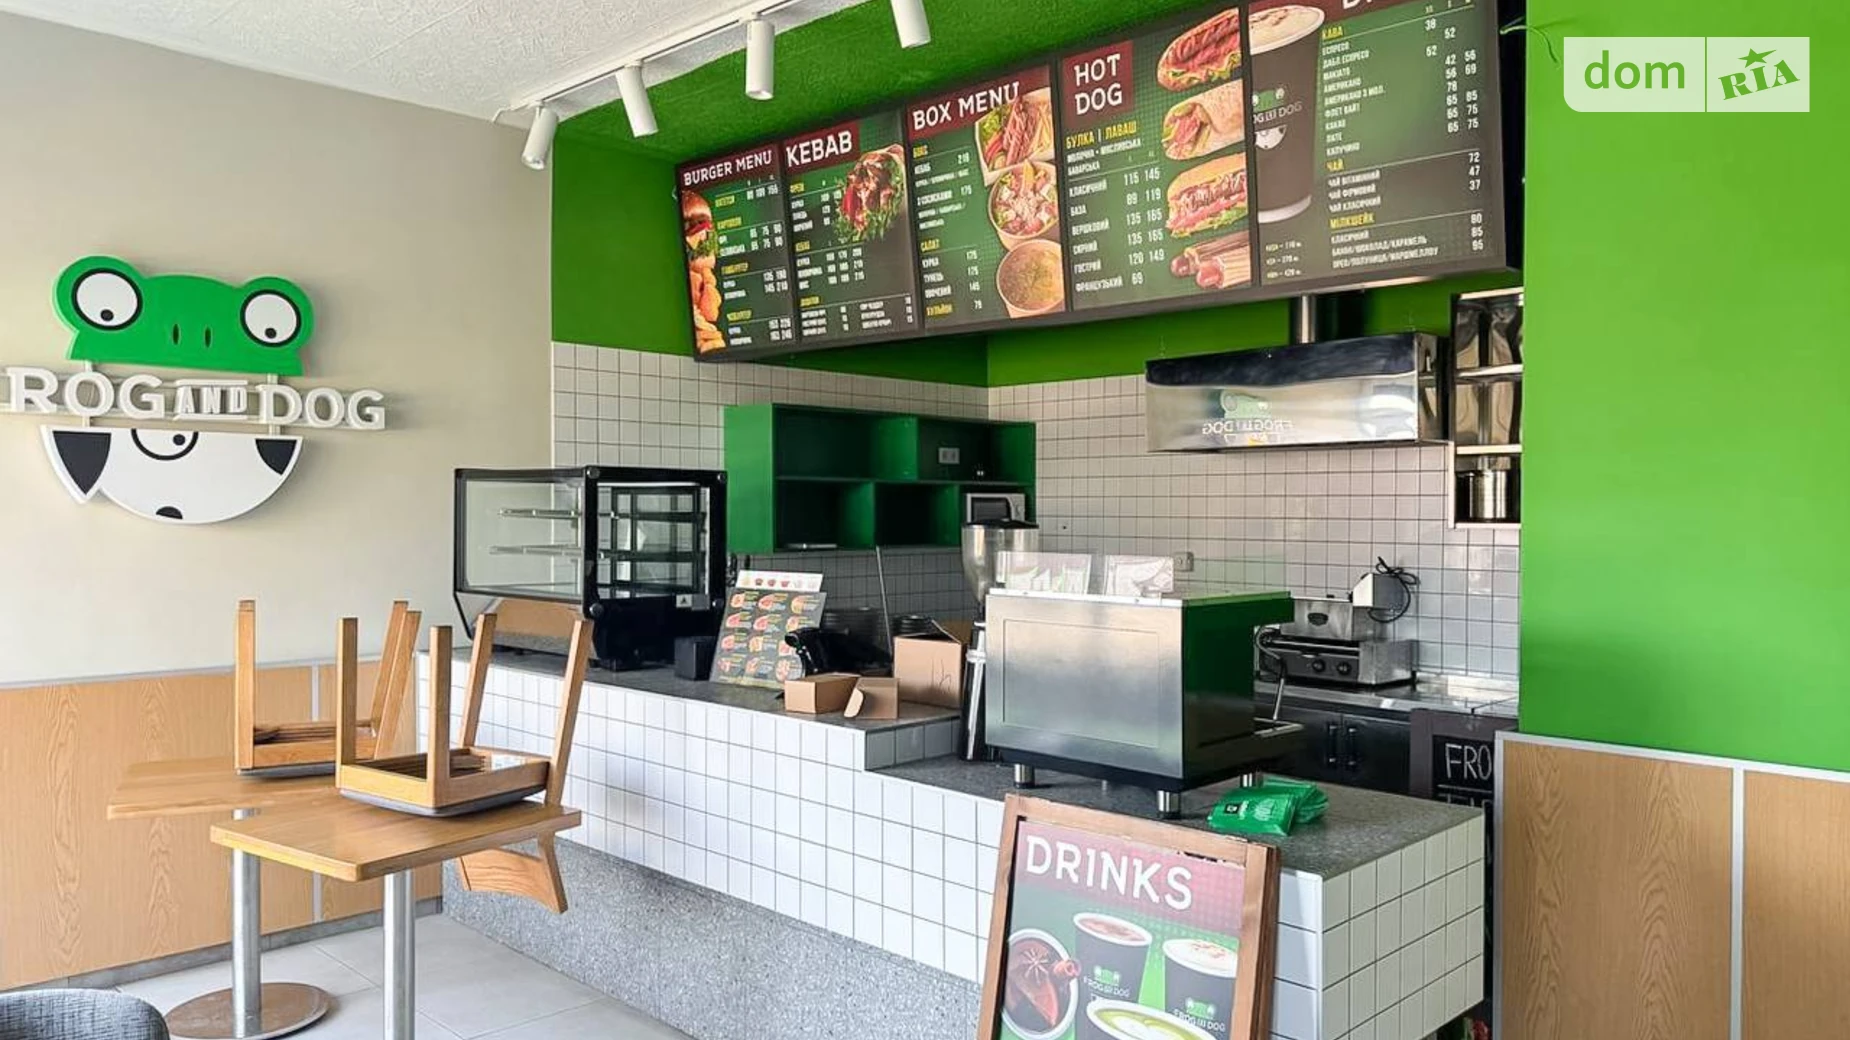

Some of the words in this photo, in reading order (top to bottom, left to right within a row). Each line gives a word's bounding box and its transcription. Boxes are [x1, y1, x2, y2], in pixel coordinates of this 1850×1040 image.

[1074, 54, 1121, 86] HOT
[913, 101, 952, 131] BOX
[958, 82, 1019, 118] MENU
[1075, 83, 1122, 115] DOG
[786, 130, 853, 168] KEBAB
[1066, 130, 1095, 150] БУЛКА
[1105, 120, 1138, 141] ЛАВАШ
[684, 162, 732, 186] BURGER
[736, 150, 772, 171] MENU
[1146, 188, 1162, 202] 119
[6, 366, 166, 419] ROG
[174, 386, 249, 416] AND
[259, 384, 386, 430] DOG
[1445, 743, 1492, 780] FRO
[1026, 835, 1192, 911] DRINKS
